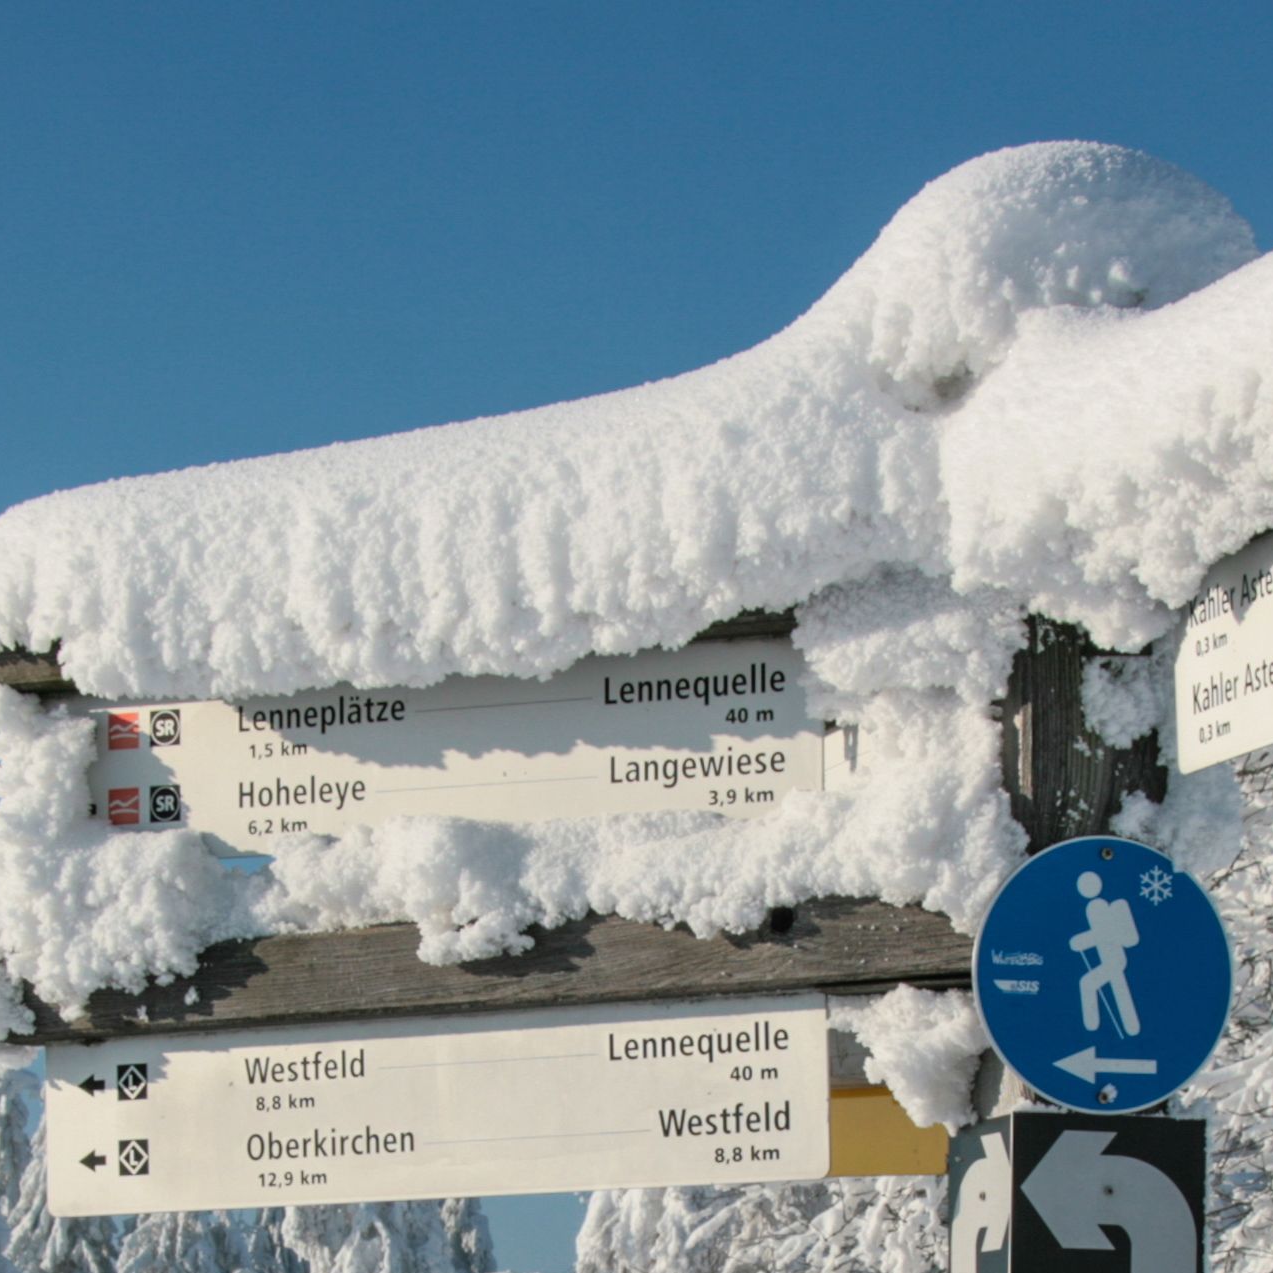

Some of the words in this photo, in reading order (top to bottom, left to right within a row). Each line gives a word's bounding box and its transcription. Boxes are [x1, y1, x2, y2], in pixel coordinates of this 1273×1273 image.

[1188, 584, 1235, 628] Kahler
[1196, 636, 1210, 657] 0,3
[1213, 633, 1228, 650] km
[604, 663, 786, 706] Lennequelle
[1192, 671, 1239, 715] Kahler
[238, 696, 406, 734] Lenneplätze
[725, 707, 748, 724] 40
[756, 709, 774, 722] m
[155, 719, 175, 737] SR
[1199, 724, 1213, 743] 0,3
[1215, 720, 1231, 736] km
[249, 743, 275, 759] 1,5
[280, 741, 308, 756] km
[610, 746, 786, 788] Langewiese
[155, 795, 175, 812] SR
[238, 776, 366, 809] Hoheleye
[708, 789, 736, 806] 3,9
[745, 787, 775, 803] km
[248, 820, 273, 837] 6,2
[280, 818, 308, 833] km
[608, 1021, 789, 1063] Lennequelle
[245, 1049, 366, 1085] Westfeld
[730, 1066, 752, 1081] 40
[761, 1067, 778, 1080] m
[256, 1096, 281, 1112] 8,8
[288, 1094, 316, 1109] km
[659, 1101, 790, 1137] Westfeld
[247, 1126, 415, 1161] Oberkirchen
[714, 1147, 743, 1164] 8,8
[751, 1146, 780, 1161] km
[259, 1172, 294, 1188] 12,9
[300, 1170, 327, 1185] km
